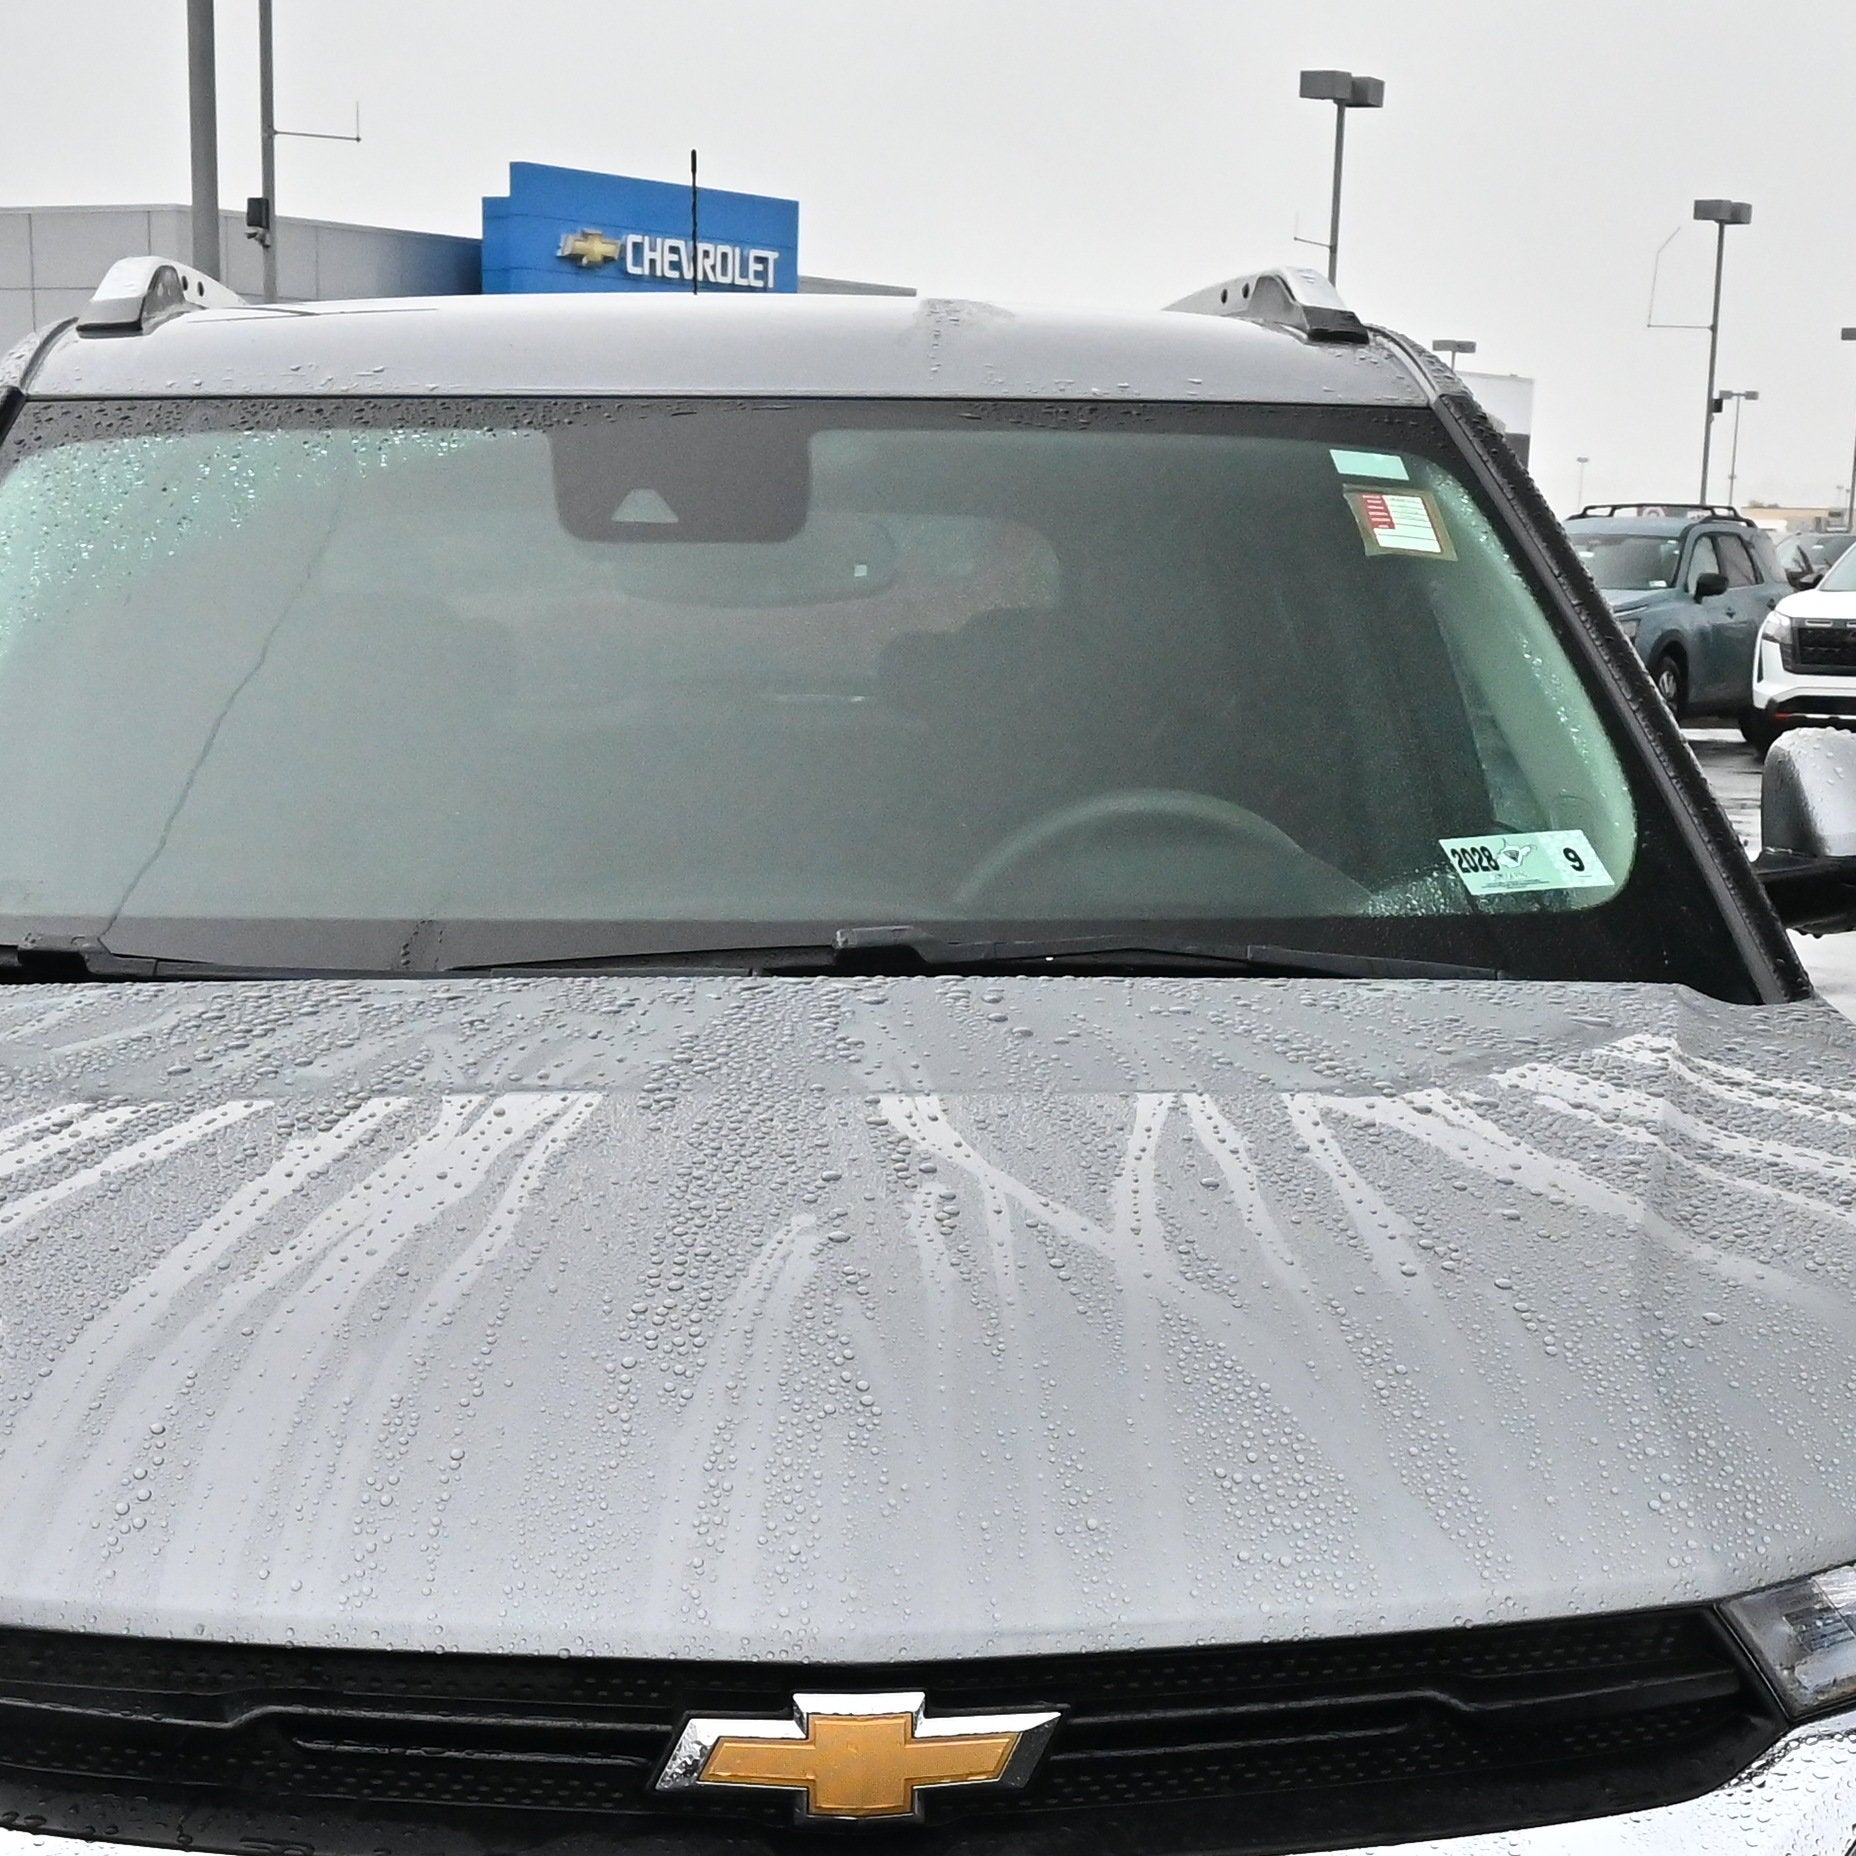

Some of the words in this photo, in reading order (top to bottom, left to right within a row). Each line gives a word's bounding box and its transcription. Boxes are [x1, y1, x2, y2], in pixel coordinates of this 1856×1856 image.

[625, 235, 780, 288] CHEVROLET
[1451, 846, 1500, 873] 2028
[1563, 848, 1585, 871] 9
